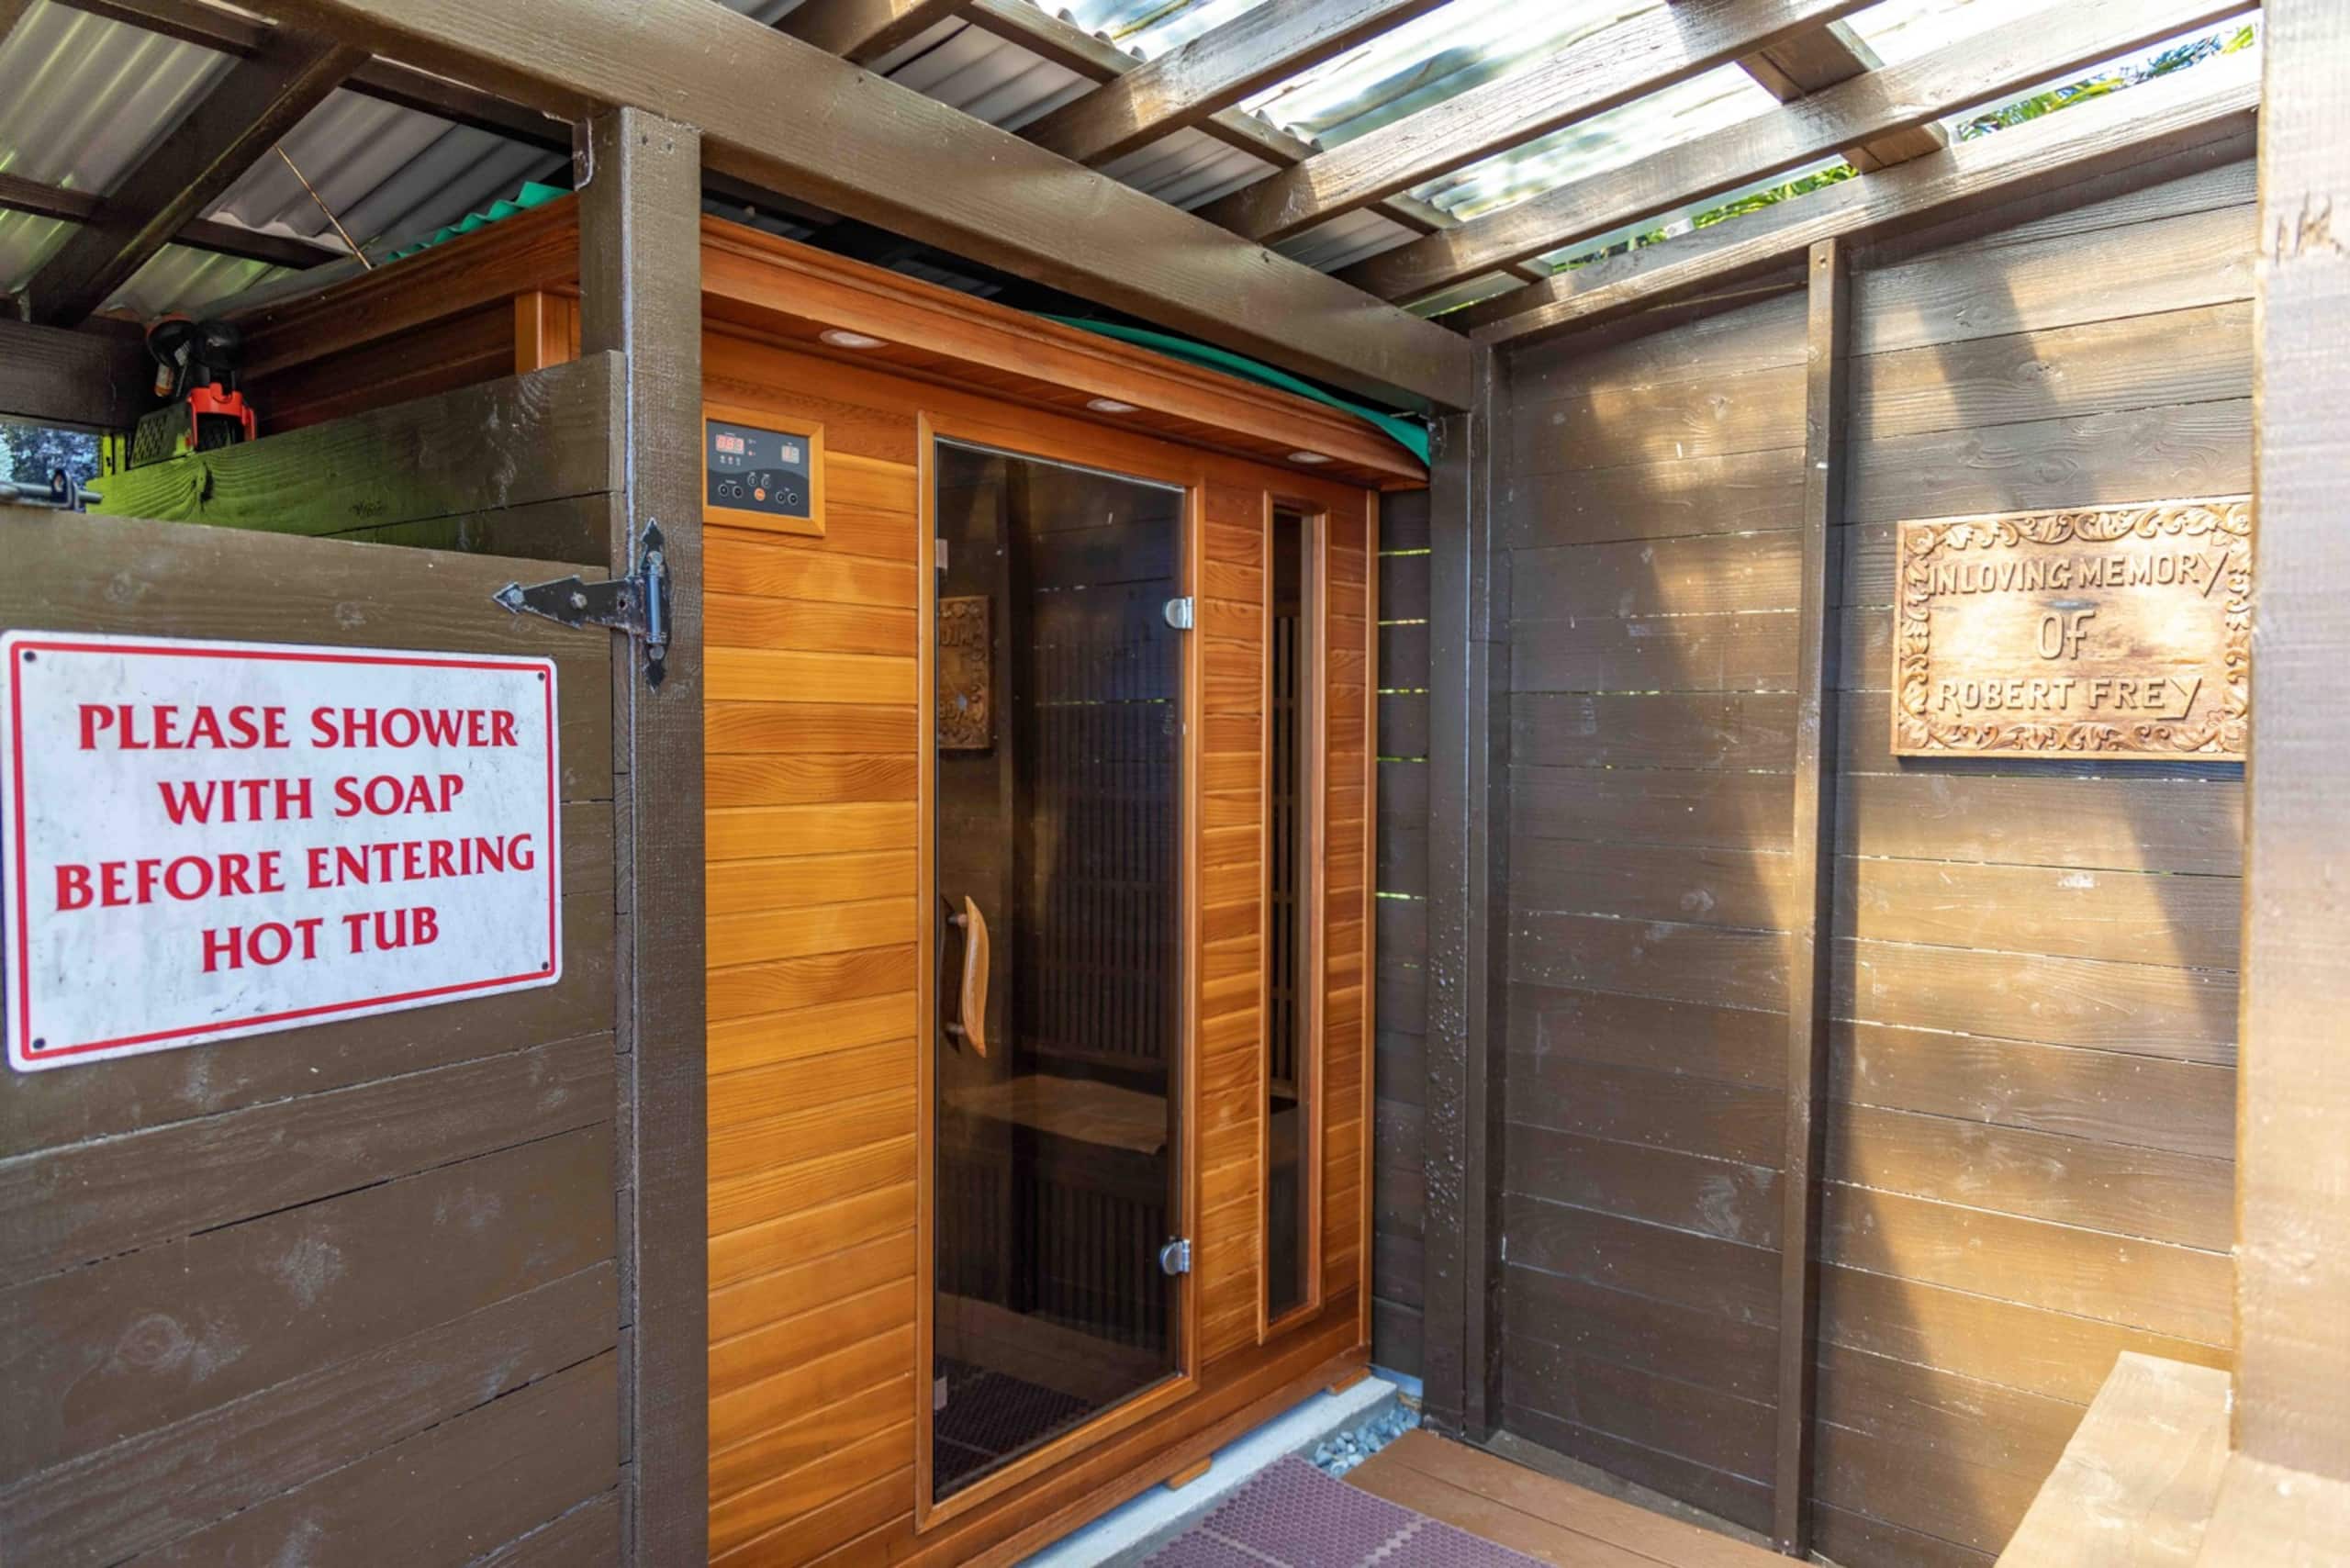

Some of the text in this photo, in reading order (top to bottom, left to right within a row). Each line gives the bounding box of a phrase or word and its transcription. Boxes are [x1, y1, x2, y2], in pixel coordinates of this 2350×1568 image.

[2078, 552, 2229, 599] MEMORY
[1937, 678, 2202, 720] ROBERT FREY
[78, 704, 519, 750] PLEASE SHOWER
[158, 774, 464, 825] WITH SOAP
[54, 834, 535, 912] BEFORE ENTERING
[201, 906, 440, 972] HOT TUB
